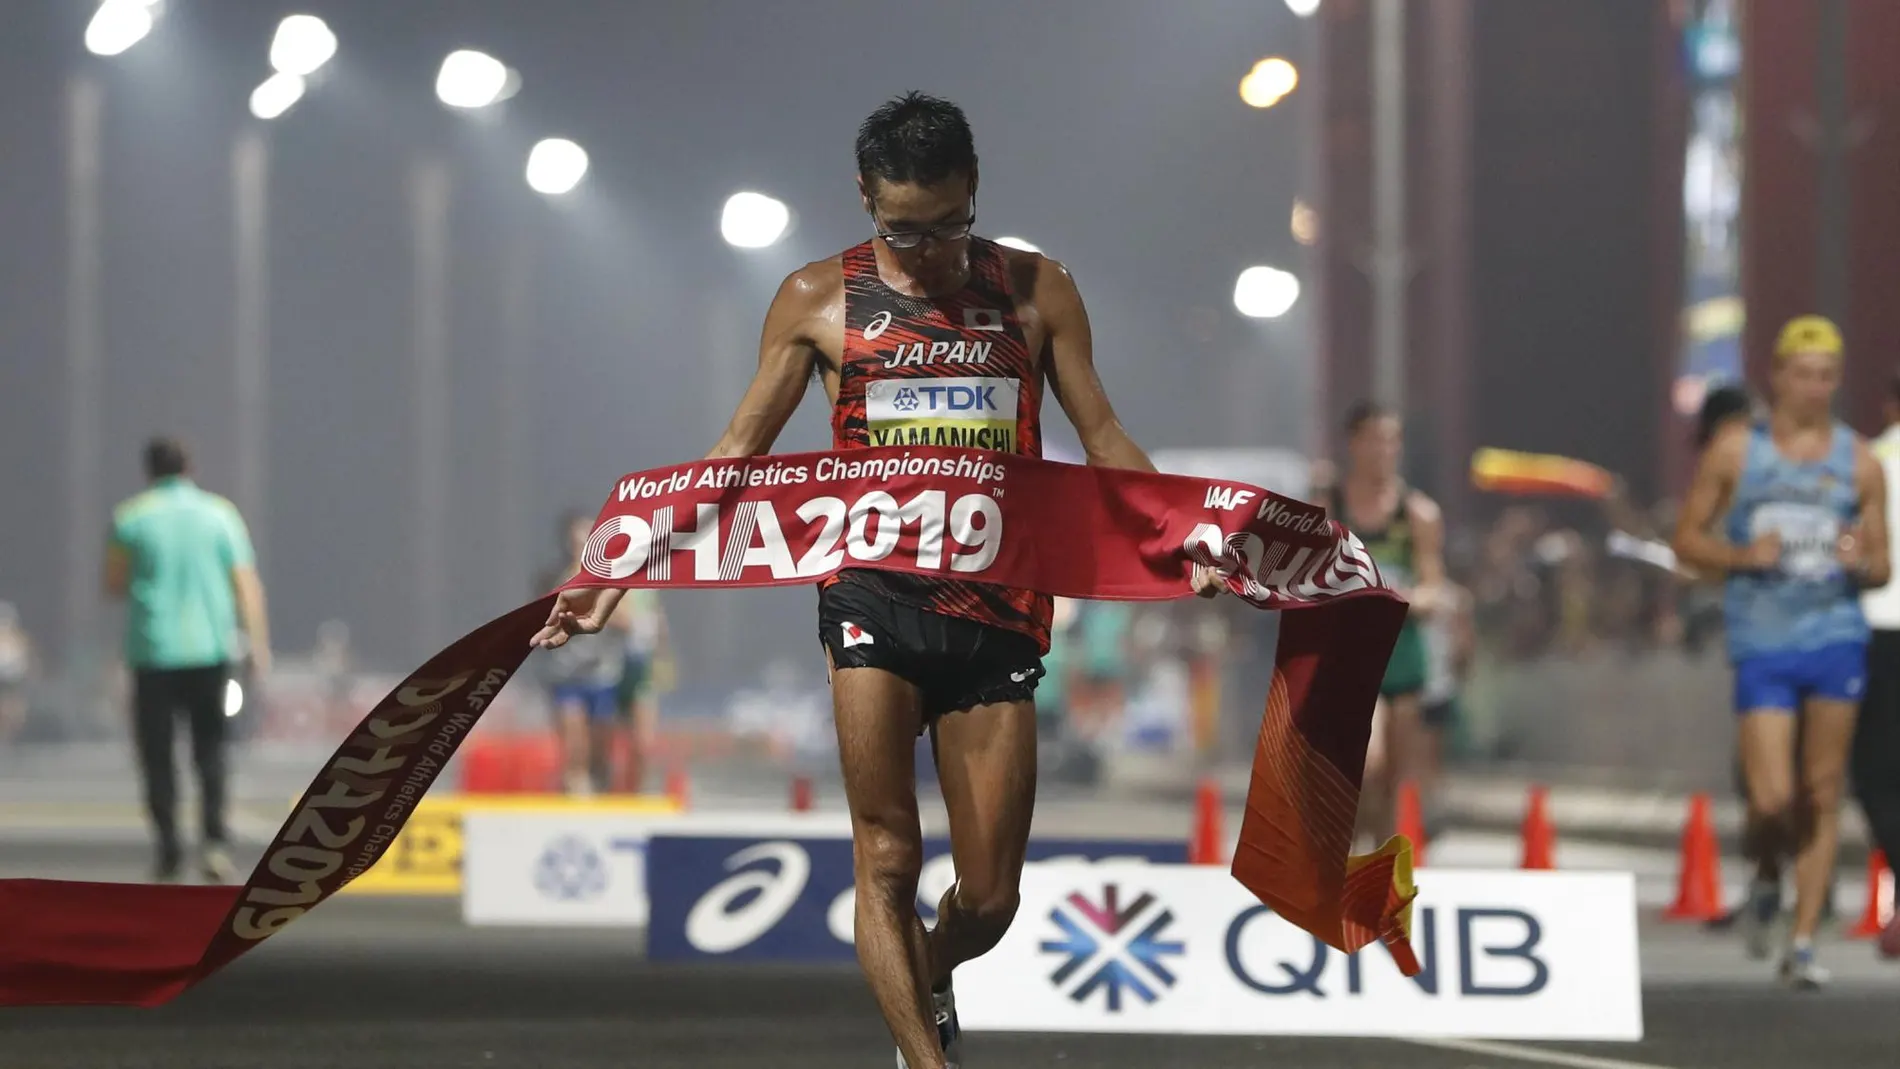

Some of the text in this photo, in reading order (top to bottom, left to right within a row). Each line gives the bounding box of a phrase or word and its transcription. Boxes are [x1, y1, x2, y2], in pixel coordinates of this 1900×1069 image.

[884, 340, 993, 369] JAPAN
[918, 386, 998, 411] TDK
[618, 452, 1005, 501] World Athletics Championships
[1203, 485, 1256, 511] IAAF
[1256, 498, 1317, 533] World
[428, 713, 474, 757] World
[384, 754, 438, 821] Athletics
[1224, 902, 1551, 998] QNB
